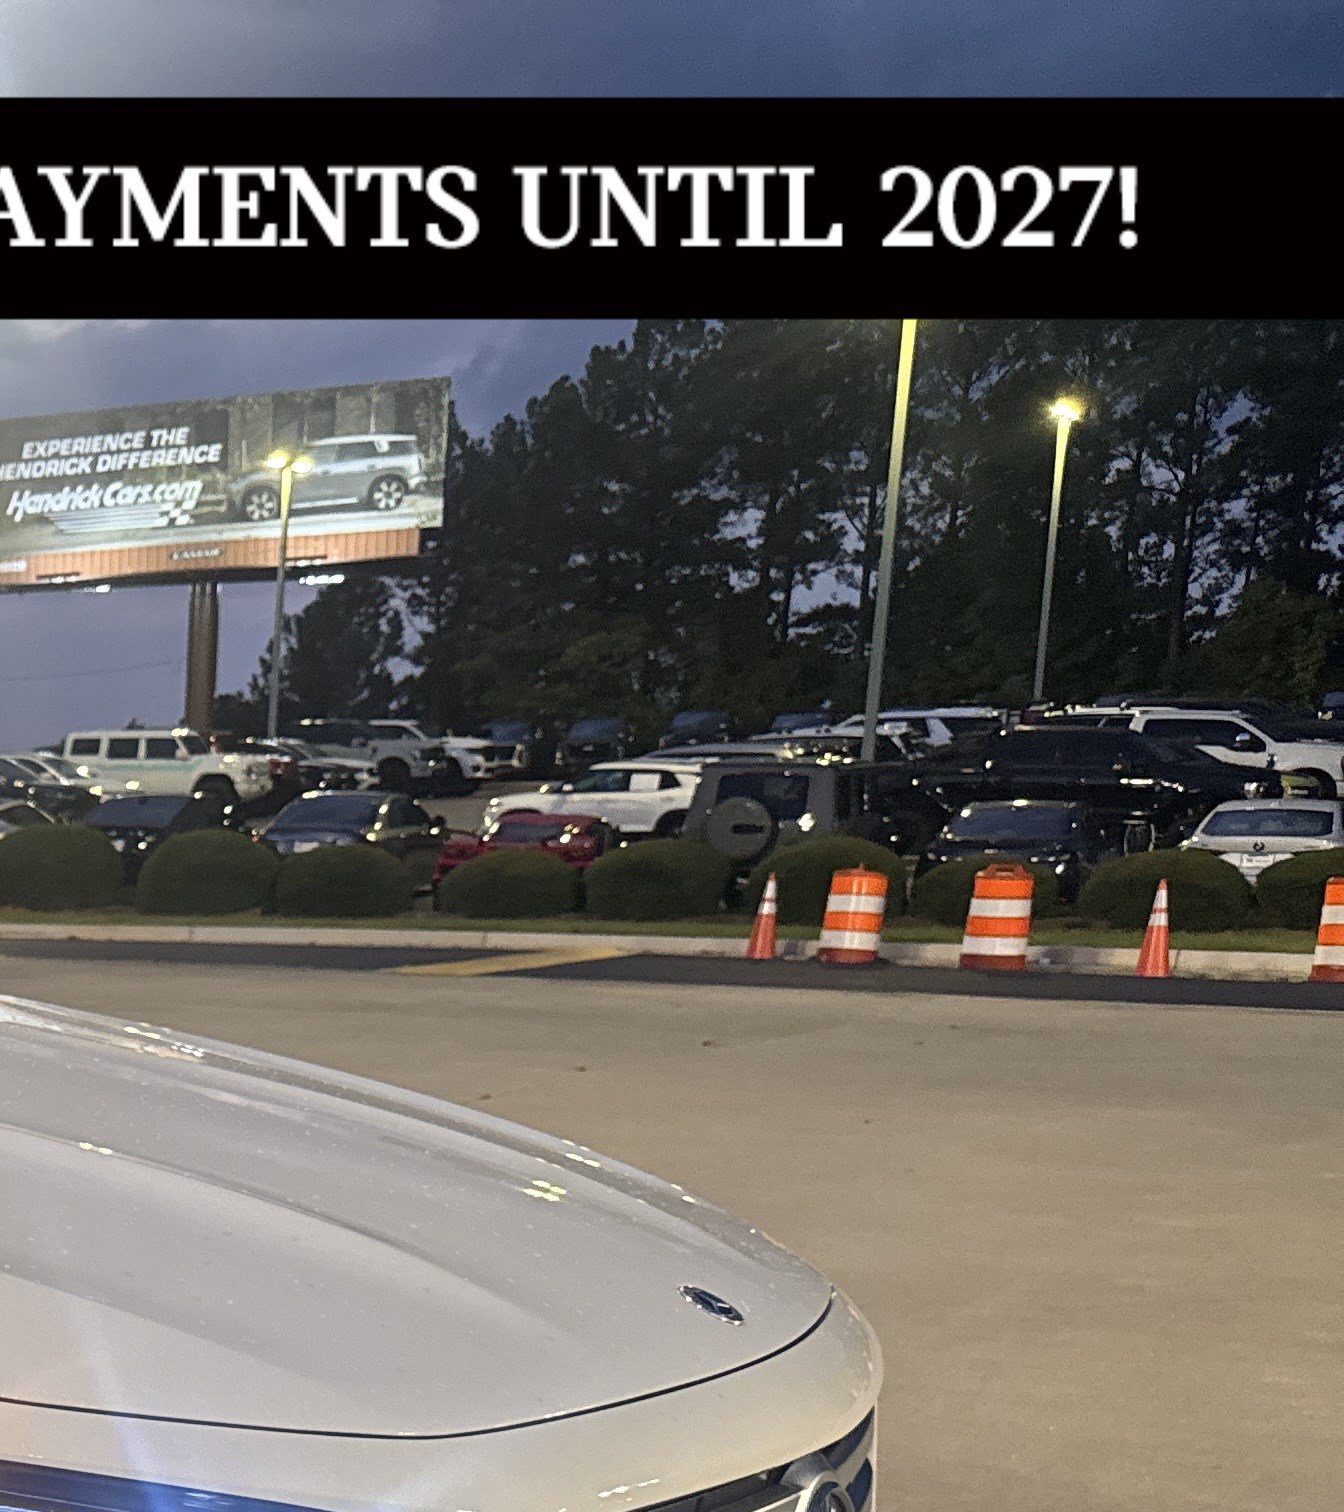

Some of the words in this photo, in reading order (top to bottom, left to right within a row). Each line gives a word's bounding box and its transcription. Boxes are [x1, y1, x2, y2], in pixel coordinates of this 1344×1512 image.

[22, 430, 146, 459] EXPERIENCE
[150, 426, 190, 447] THE
[96, 444, 222, 472] DIFFERENCE
